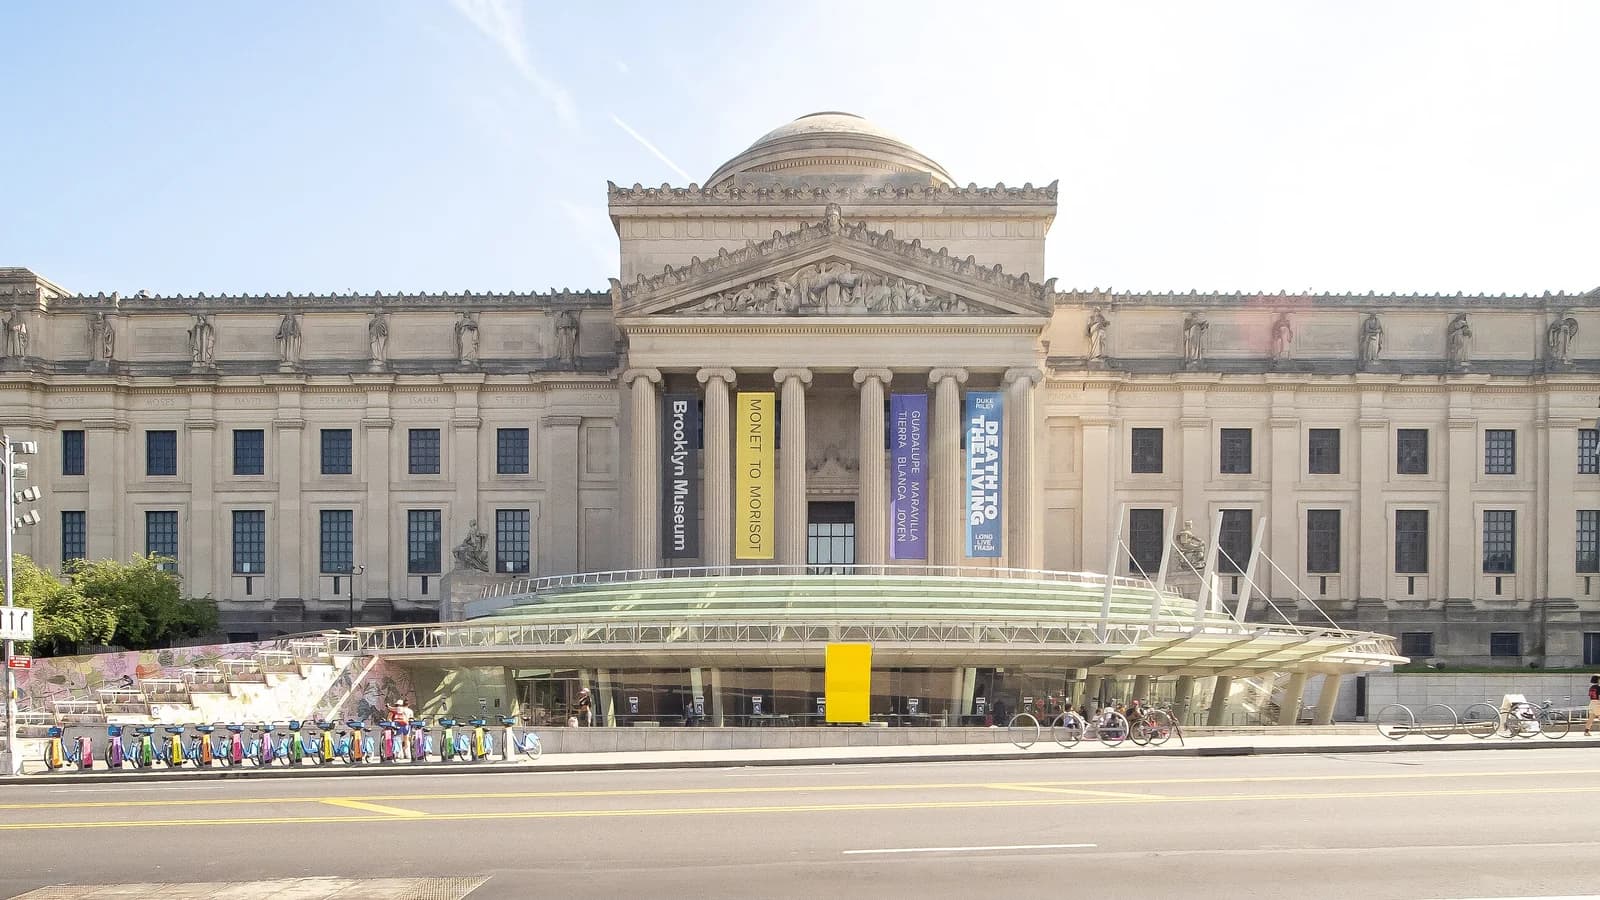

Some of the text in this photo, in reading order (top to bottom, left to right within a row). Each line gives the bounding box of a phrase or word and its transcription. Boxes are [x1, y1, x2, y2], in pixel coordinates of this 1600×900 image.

[314, 396, 361, 405] EREMIAH
[670, 400, 689, 551] Brooklyn Museum
[749, 399, 762, 552] MONET TO MORISOT
[897, 410, 907, 542] TIERRA BLANCA JOVEN
[910, 410, 920, 542] GUADALUPE MARAVILLA
[970, 415, 985, 526] THE LIVING
[984, 421, 998, 520] DEATH TO
